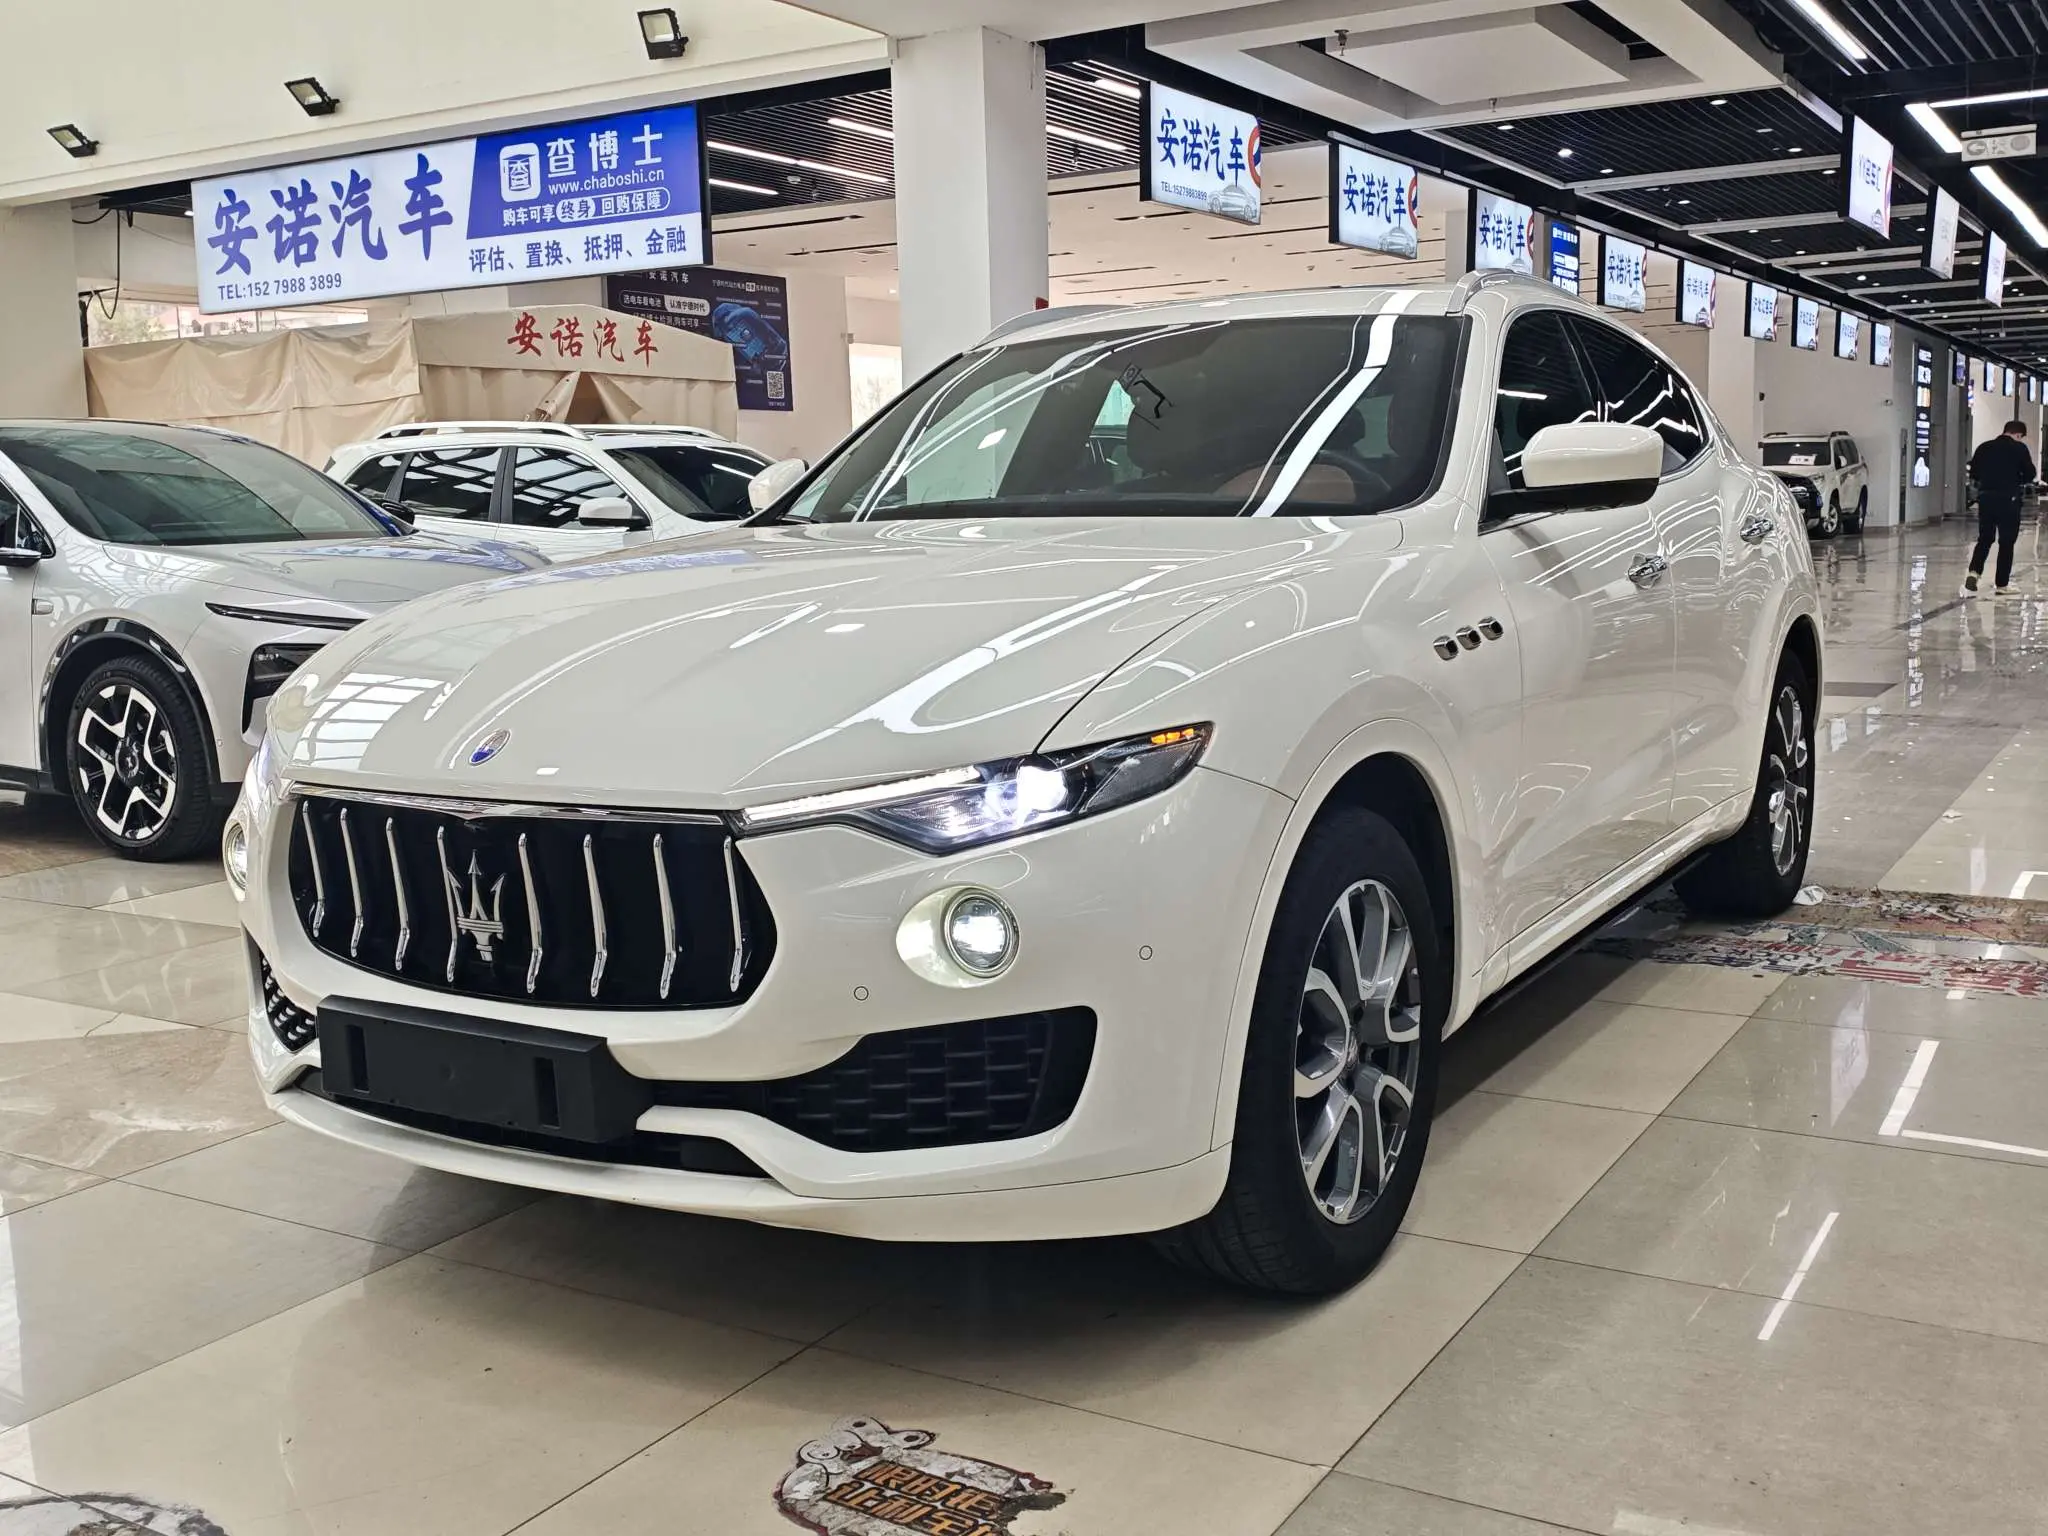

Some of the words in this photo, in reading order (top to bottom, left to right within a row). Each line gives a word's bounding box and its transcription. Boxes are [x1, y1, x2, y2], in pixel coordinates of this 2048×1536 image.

[546, 124, 662, 178] 查博士
[1157, 108, 1246, 188] 安诺汽车
[549, 168, 664, 195] www.chaboshi.cn
[1343, 165, 1406, 229] 安诺汽车
[207, 152, 453, 275] 安诺汽车
[1479, 207, 1525, 259] 安诺汽车
[218, 281, 270, 300] TEL:152
[274, 277, 306, 296] 7988
[310, 273, 342, 292] 3899
[1608, 250, 1640, 290] 安诺汽车
[508, 312, 658, 367] 安诺汽车
